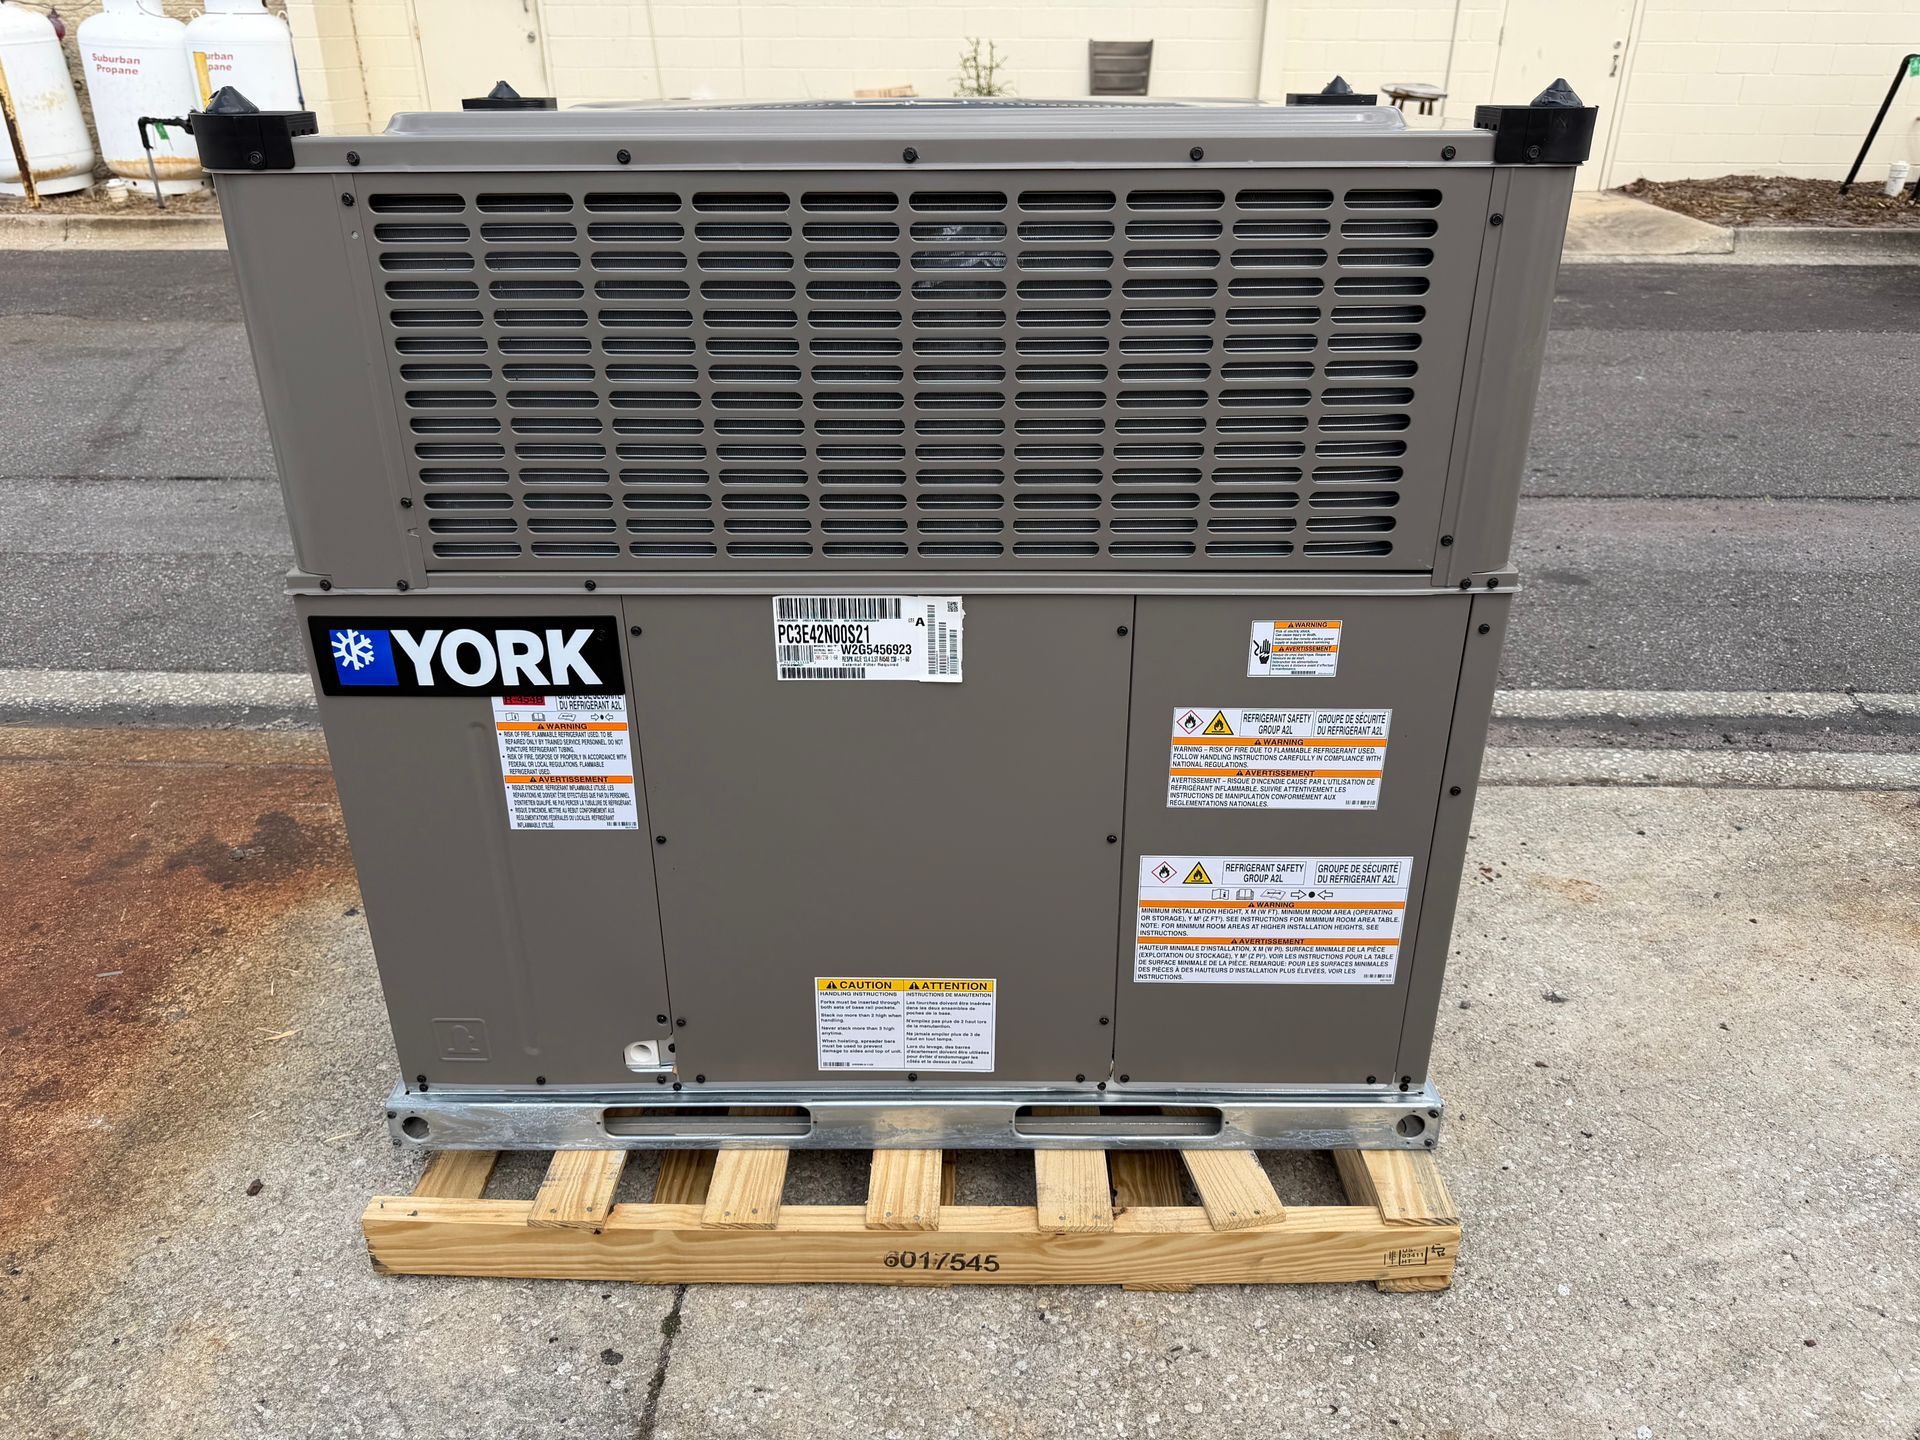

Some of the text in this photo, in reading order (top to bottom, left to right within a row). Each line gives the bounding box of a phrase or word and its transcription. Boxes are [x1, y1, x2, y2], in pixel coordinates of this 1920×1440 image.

[92, 53, 140, 64] Suburban
[96, 64, 138, 75] Propane
[915, 618, 926, 626] A
[778, 624, 870, 644] PC3E42N00S21
[841, 644, 912, 655] W2G5456923
[390, 628, 602, 686] YORK
[1243, 714, 1311, 723] REFRIGERANT SAFETY
[1318, 712, 1386, 724] GROUPE DE SÉCURITÉ
[1259, 725, 1293, 734] GROUP A2L
[1317, 724, 1383, 735] DU RÉFRIGÉRANT A2L
[1226, 864, 1304, 872] REFRIGERANT SAFETY
[1318, 862, 1398, 873] GROUPE DE SÉCURITÉ
[1244, 874, 1283, 882] GROUP A2L
[1317, 873, 1396, 883] DU RÉFRIGÉRANT A2L
[884, 1250, 1000, 1272] 6017545
